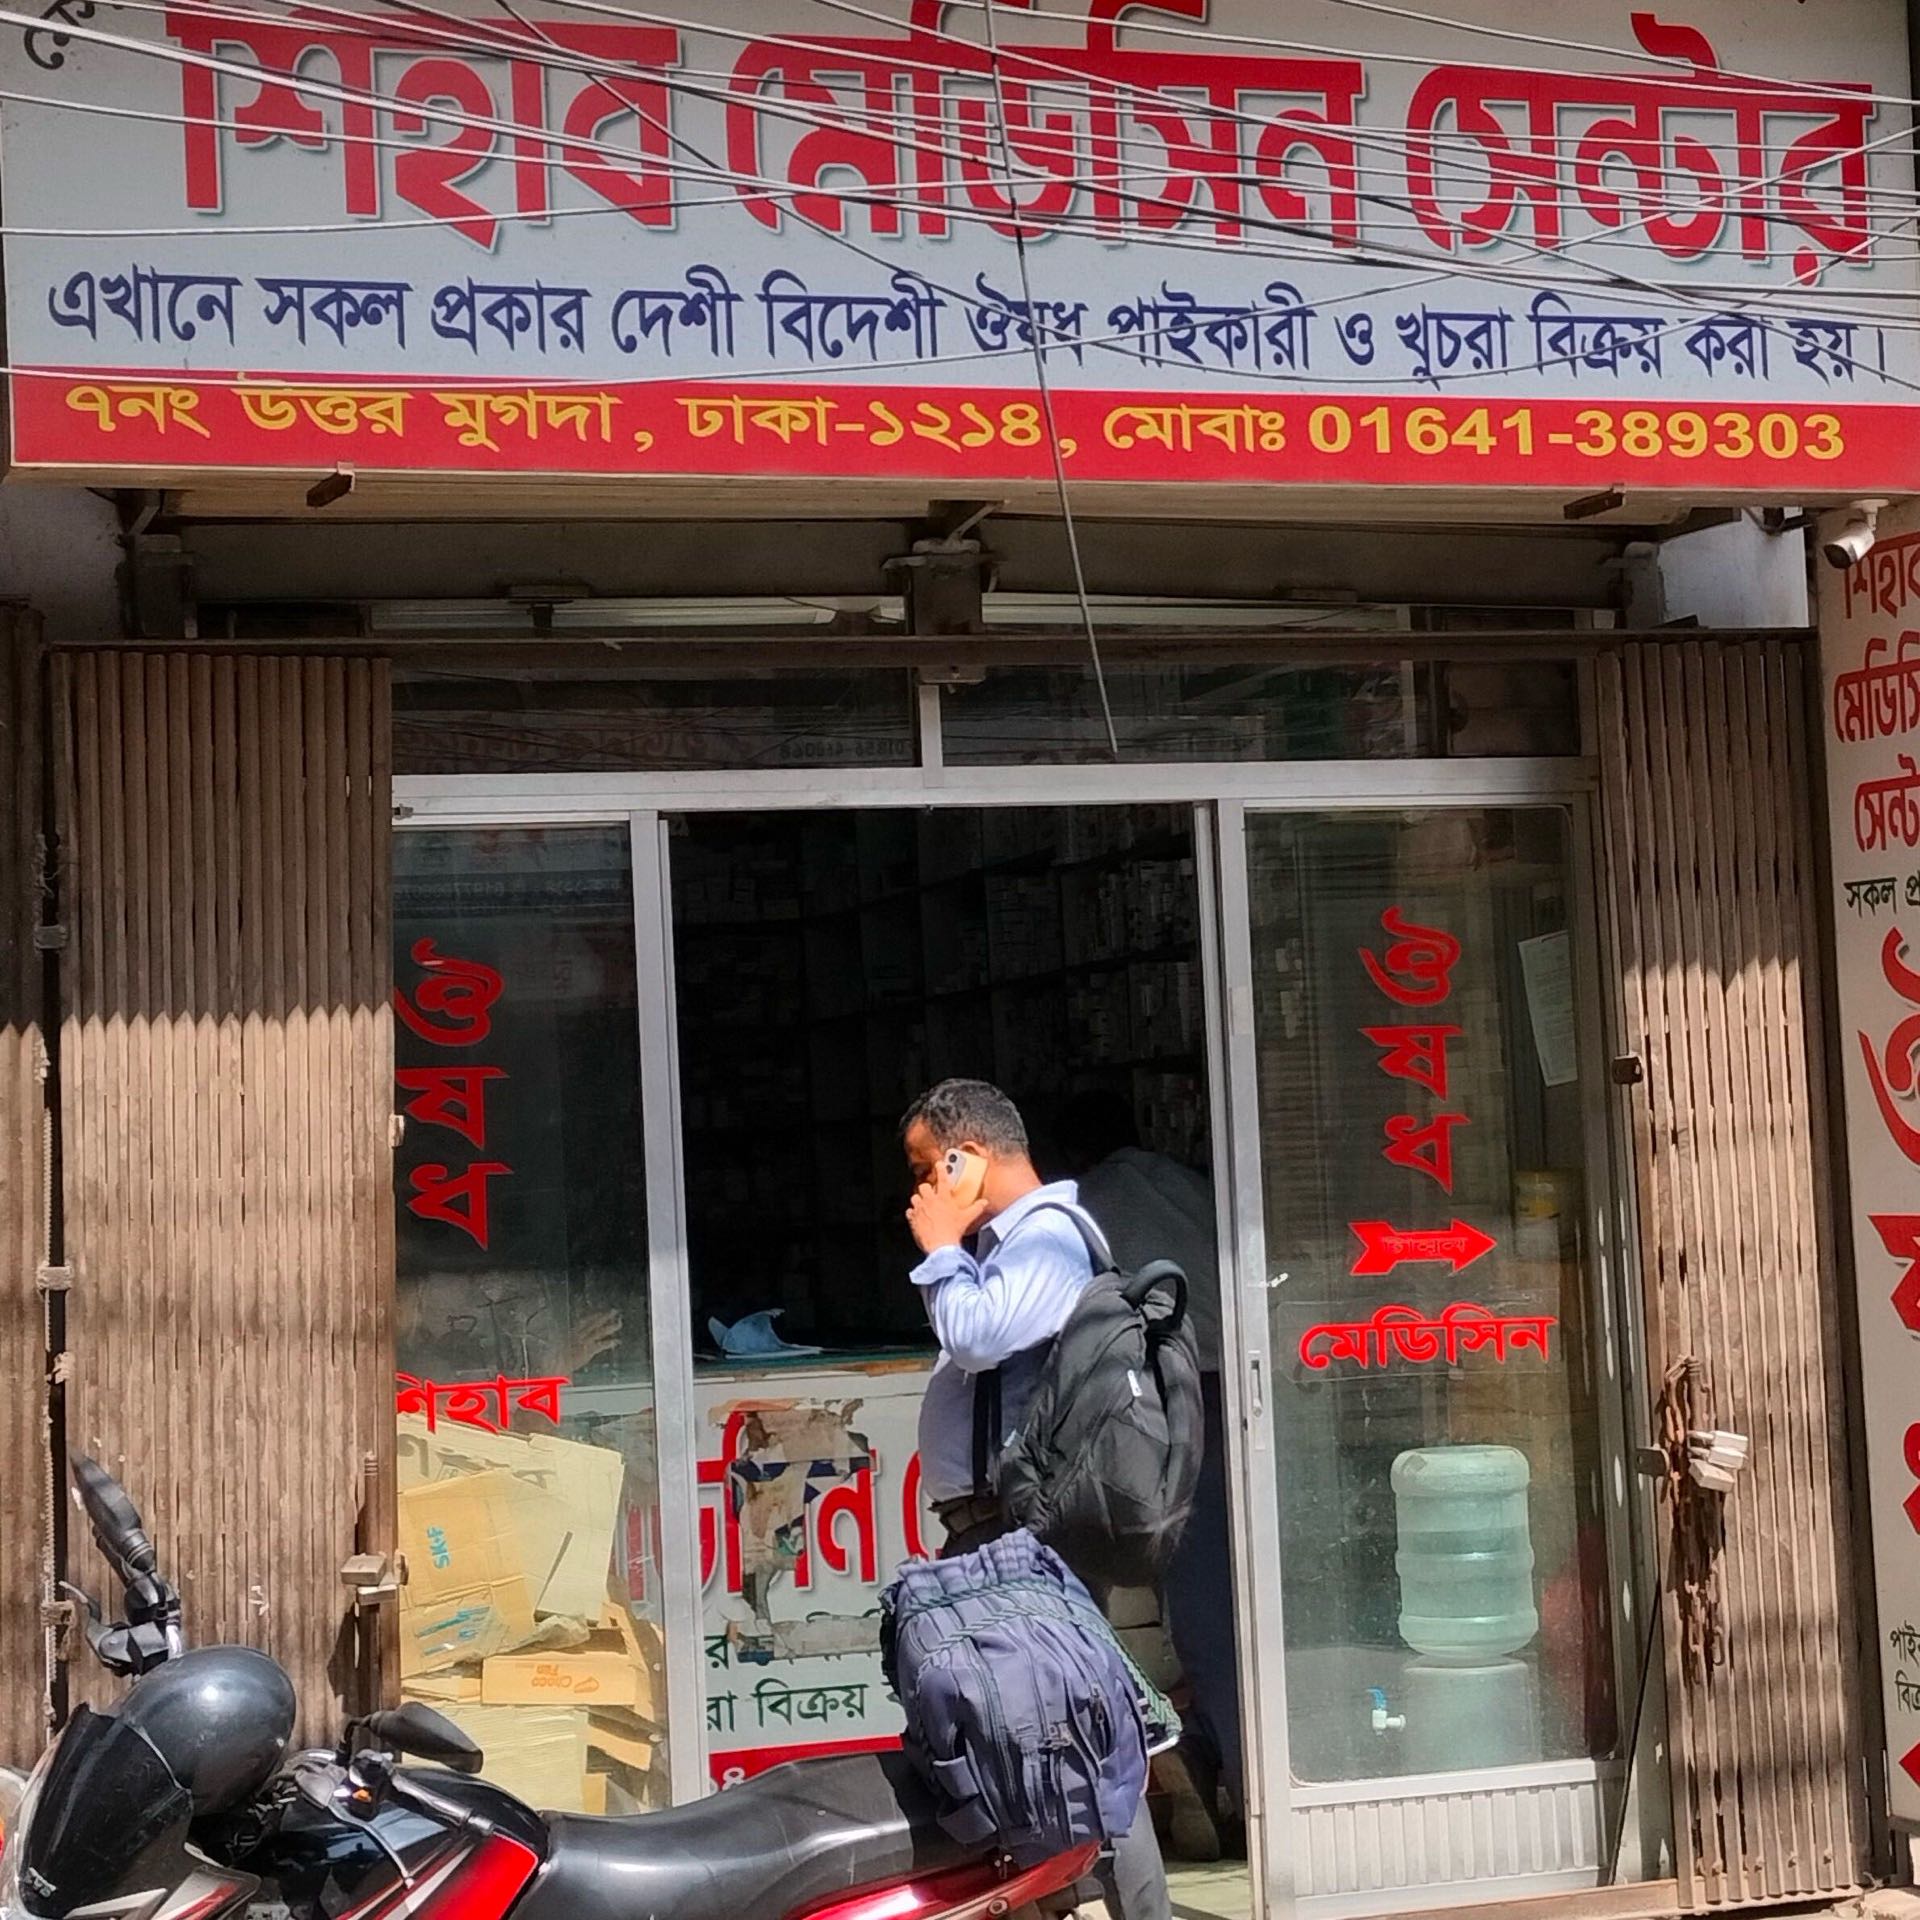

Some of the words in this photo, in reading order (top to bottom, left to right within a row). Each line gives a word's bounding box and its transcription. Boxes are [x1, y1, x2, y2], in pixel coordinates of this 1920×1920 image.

[165, 0, 682, 249] শিহাব
[725, 0, 1366, 250] মেডিসিন
[1406, 11, 1876, 287] সেন্টার
[50, 263, 240, 344] এখানে
[257, 278, 413, 350] সকল
[430, 278, 592, 356] প্রকার
[611, 264, 746, 358] দেশী
[755, 268, 951, 361] বিদেশী
[964, 272, 1089, 366] ঔষধ
[1107, 280, 1317, 369] পাইকারী
[1335, 312, 1375, 367] ও
[1396, 303, 1515, 390] খুচরা
[1526, 291, 1667, 378] বিক্রয়
[1684, 308, 1770, 380] করা
[65, 385, 210, 440] ৭নং
[230, 387, 414, 438] উত্তর
[1103, 403, 1286, 454] মোবাঃ
[1308, 405, 1845, 460] 01641-389303
[1844, 531, 1920, 619] শহা
[1843, 877, 1898, 918] সকল
[1359, 905, 1471, 1196] ঔষধ
[395, 937, 514, 1250] ঔষধ
[1299, 1303, 1558, 1370] মেডিসিন
[1890, 1620, 1920, 1668] পাই
[751, 1677, 870, 1728] বিক্রয়
